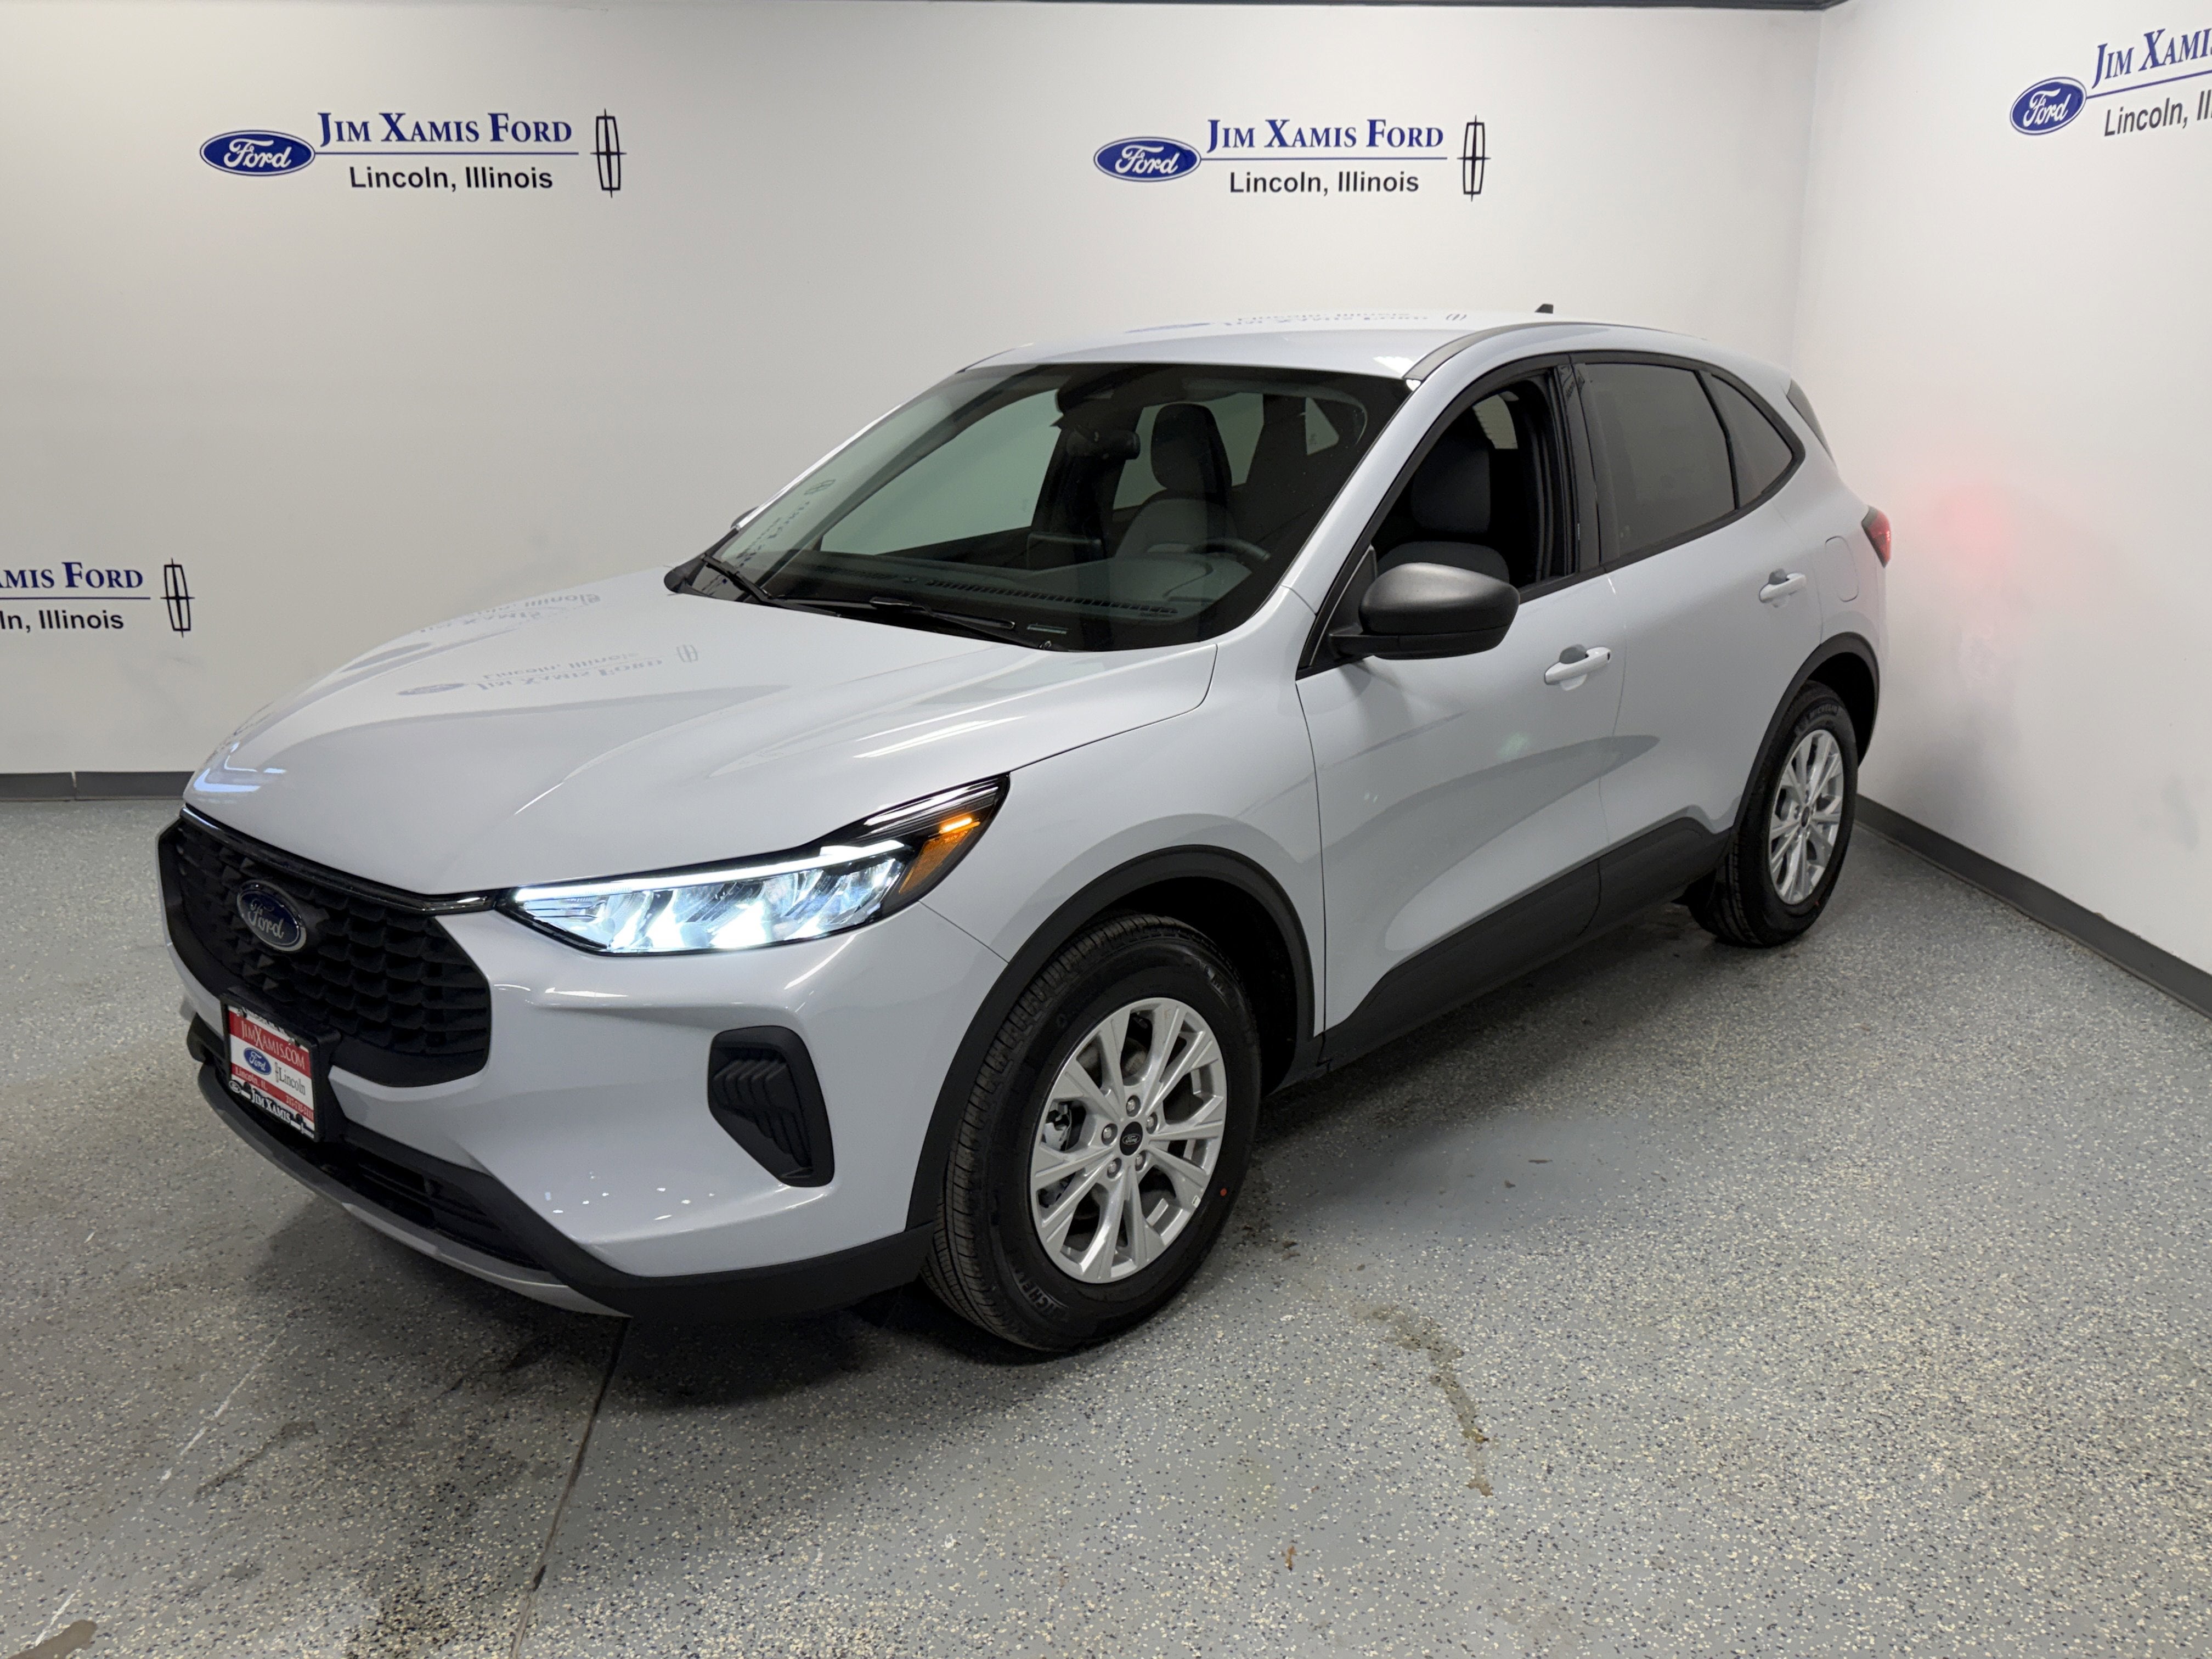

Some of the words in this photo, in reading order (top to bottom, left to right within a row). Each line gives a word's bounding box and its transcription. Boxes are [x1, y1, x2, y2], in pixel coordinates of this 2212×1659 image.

[2092, 43, 2135, 89] JIM
[2138, 28, 2212, 72] XAMI
[2023, 88, 2072, 127] Ford
[2104, 97, 2188, 137] Lincoln,
[318, 112, 371, 148] JIM
[379, 112, 479, 142] XAMIS
[488, 113, 572, 142] FORD
[1206, 119, 1255, 153] JIM
[1264, 119, 1357, 148] XAMIS
[1366, 119, 1443, 148] FORD
[223, 139, 292, 168] Ford
[1115, 143, 1179, 175] Ford
[349, 166, 456, 192] Lincoln,
[465, 167, 552, 189] Illinois
[1231, 171, 1328, 196] Lincoln,
[1338, 171, 1419, 192] Illinois
[0, 569, 55, 588] MIS
[61, 562, 143, 588] FORD
[38, 610, 124, 629] Illinois
[247, 898, 284, 939] Ford
[241, 1020, 306, 1070] JIMXAMIS.COM
[249, 1051, 266, 1071] Ford
[278, 1066, 306, 1096] Lincoln
[251, 1089, 266, 1108] JIM
[266, 1098, 291, 1124] XAMIS
